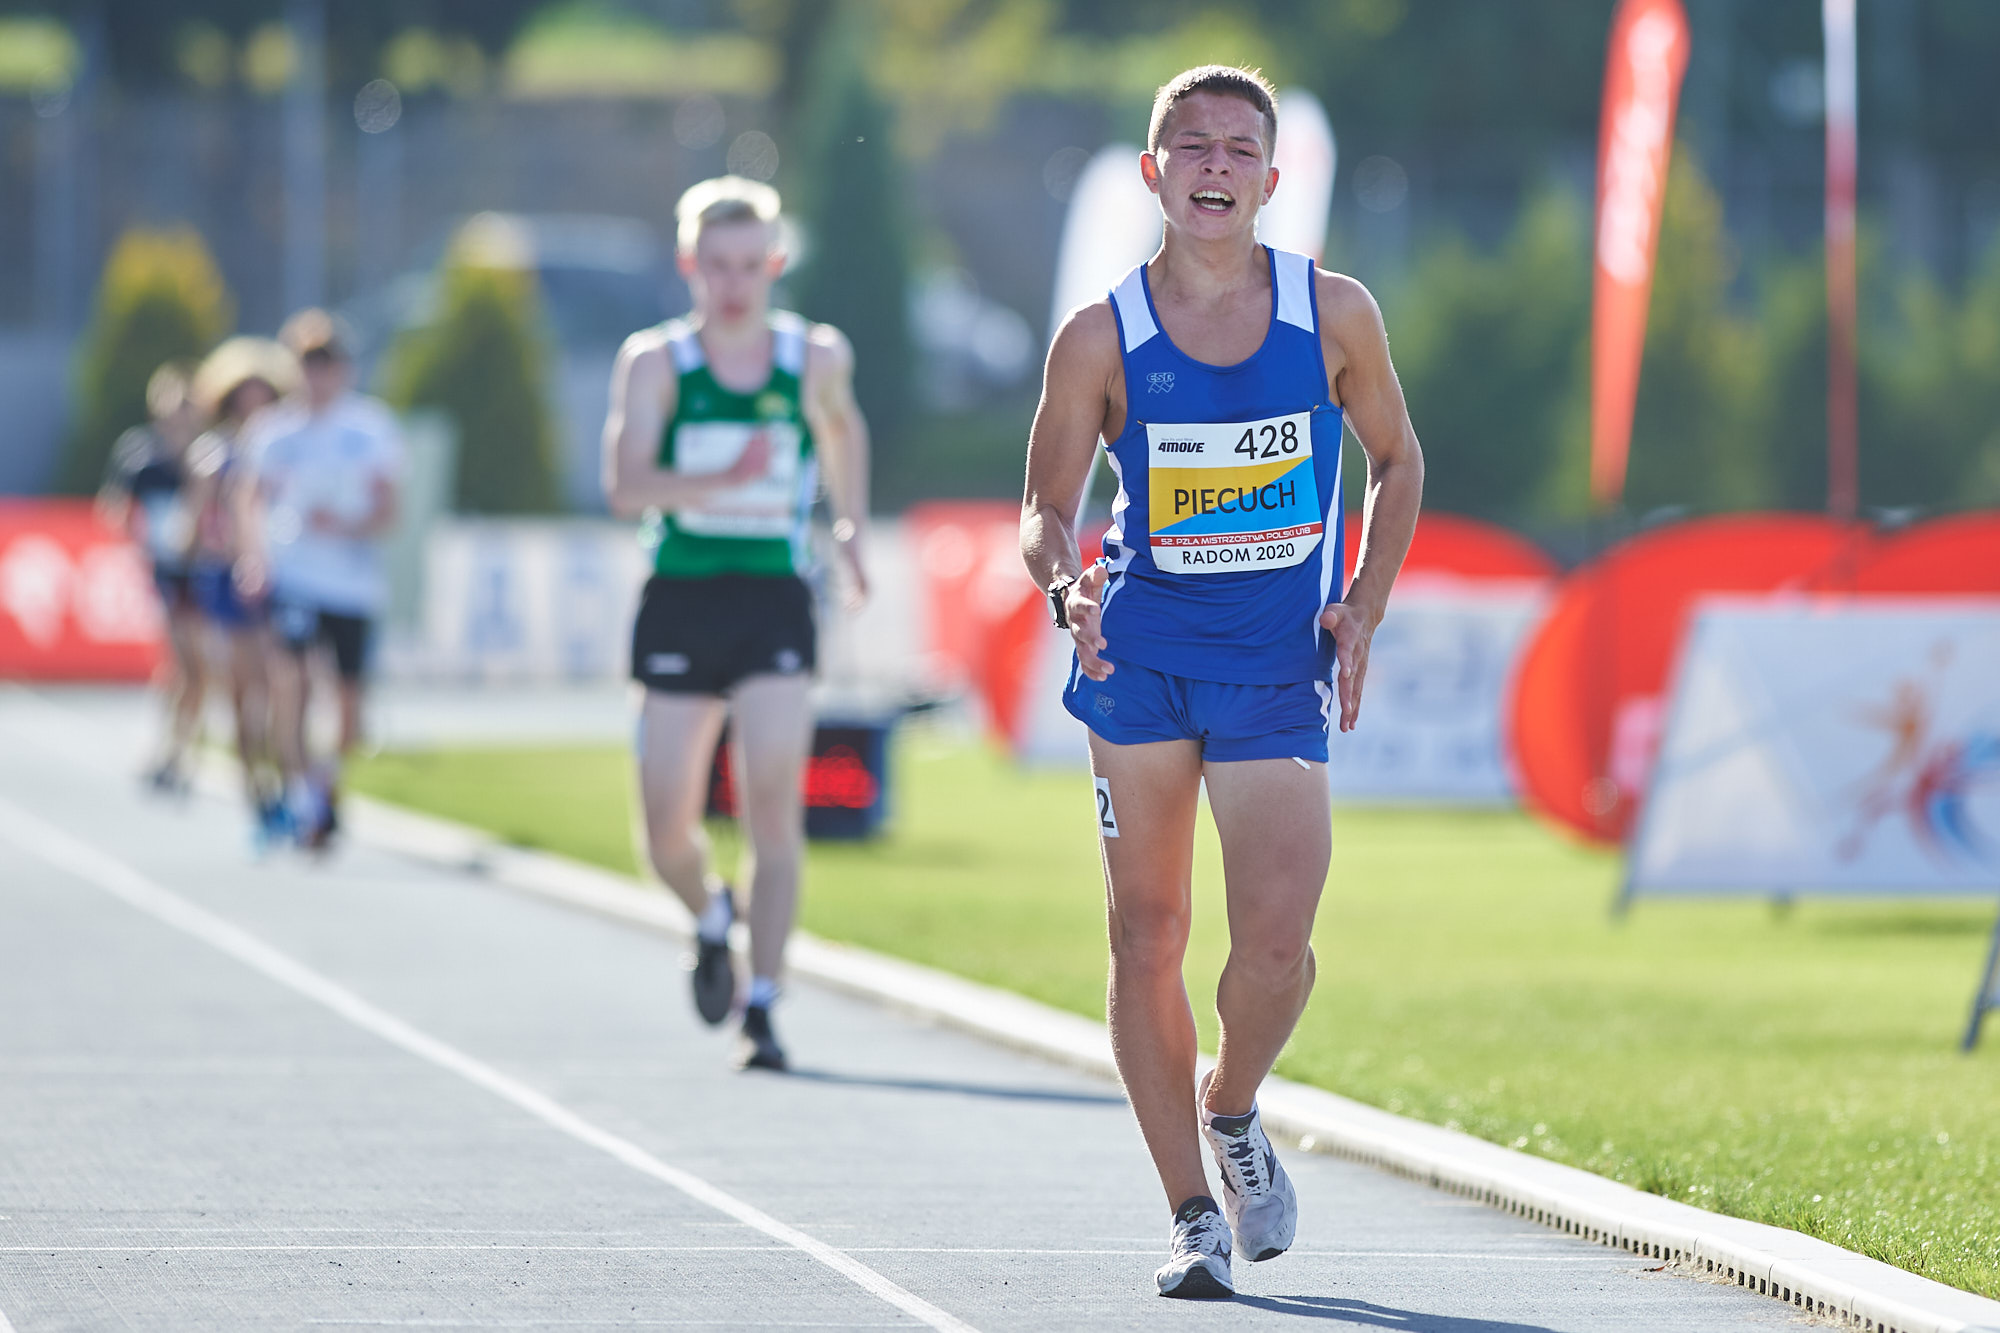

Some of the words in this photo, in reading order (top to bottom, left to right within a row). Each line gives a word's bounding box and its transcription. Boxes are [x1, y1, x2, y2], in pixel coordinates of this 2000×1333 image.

[1158, 442, 1205, 453] 4MOVE
[1234, 421, 1299, 460] 428
[1174, 480, 1296, 515] PIECUCH
[1176, 537, 1199, 545] PZLA
[1200, 534, 1265, 545] MISTRZOSTWA
[1266, 530, 1295, 541] POLSKI
[1296, 526, 1311, 536] U18
[1182, 548, 1251, 565] RADOM
[1256, 542, 1295, 561] 2020
[1096, 788, 1115, 829] 2
